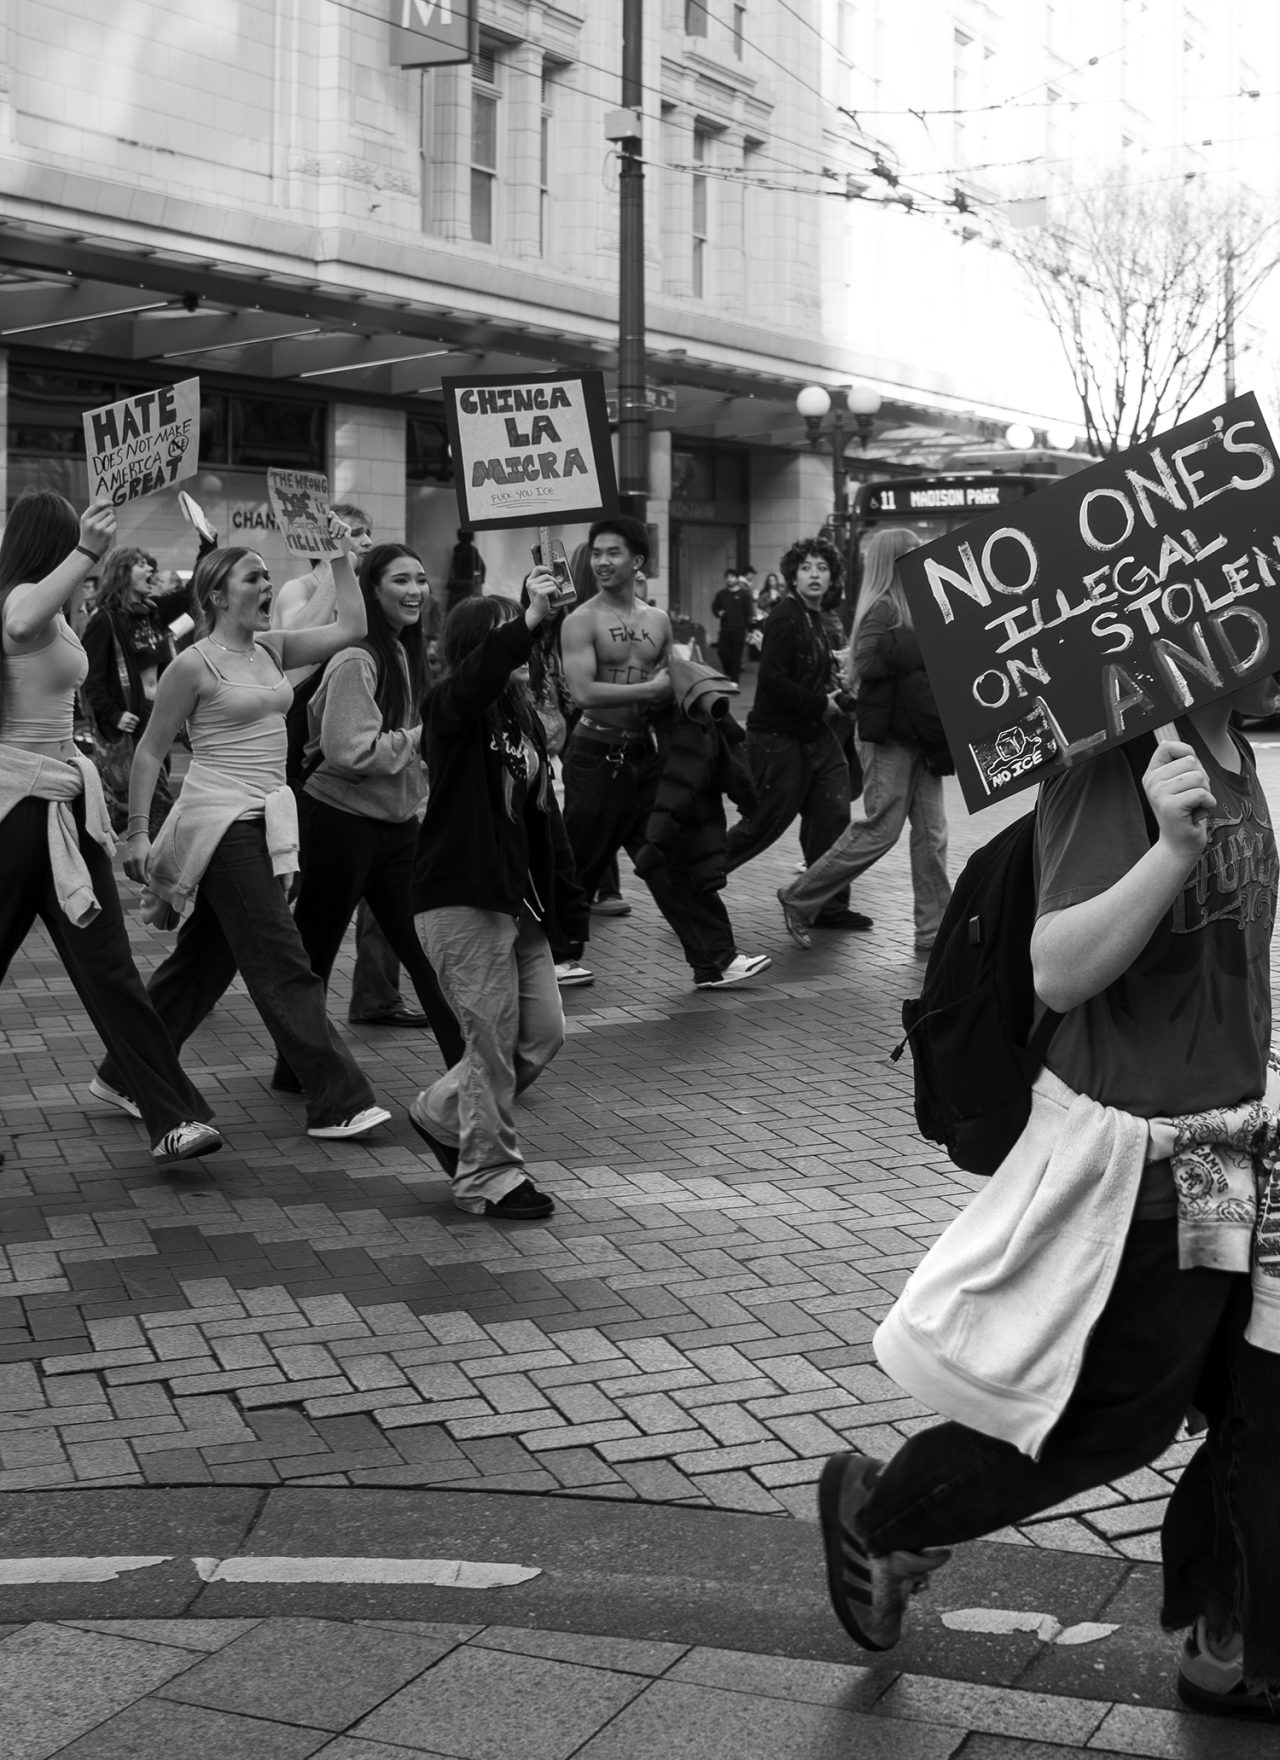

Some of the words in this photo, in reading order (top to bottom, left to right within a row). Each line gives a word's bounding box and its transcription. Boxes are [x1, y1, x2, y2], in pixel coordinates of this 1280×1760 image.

[91, 385, 177, 455] HATE
[504, 415, 562, 448] LA
[93, 447, 123, 476] DOES
[126, 436, 153, 460] NOT
[154, 418, 192, 446] MAKE
[472, 448, 588, 487] MIGRA
[95, 451, 162, 496] AMERICA
[112, 456, 182, 507] GREAT
[270, 471, 294, 489] THE
[295, 475, 327, 494] WRONG
[516, 489, 533, 499] YOU
[535, 487, 555, 496] ICE
[232, 511, 280, 530] CHAN
[881, 490, 897, 511] 11
[910, 489, 965, 508] MADISON
[966, 487, 1000, 505] PARK
[923, 527, 1039, 625] NO
[1079, 415, 1276, 552] ONE'S
[984, 529, 1228, 654] ILLEGAL
[972, 647, 1052, 708] ON
[1036, 606, 1270, 768] LAND
[992, 770, 1012, 788] NO
[1011, 750, 1043, 777] ICE
[1190, 1146, 1229, 1193] CAMPUS
